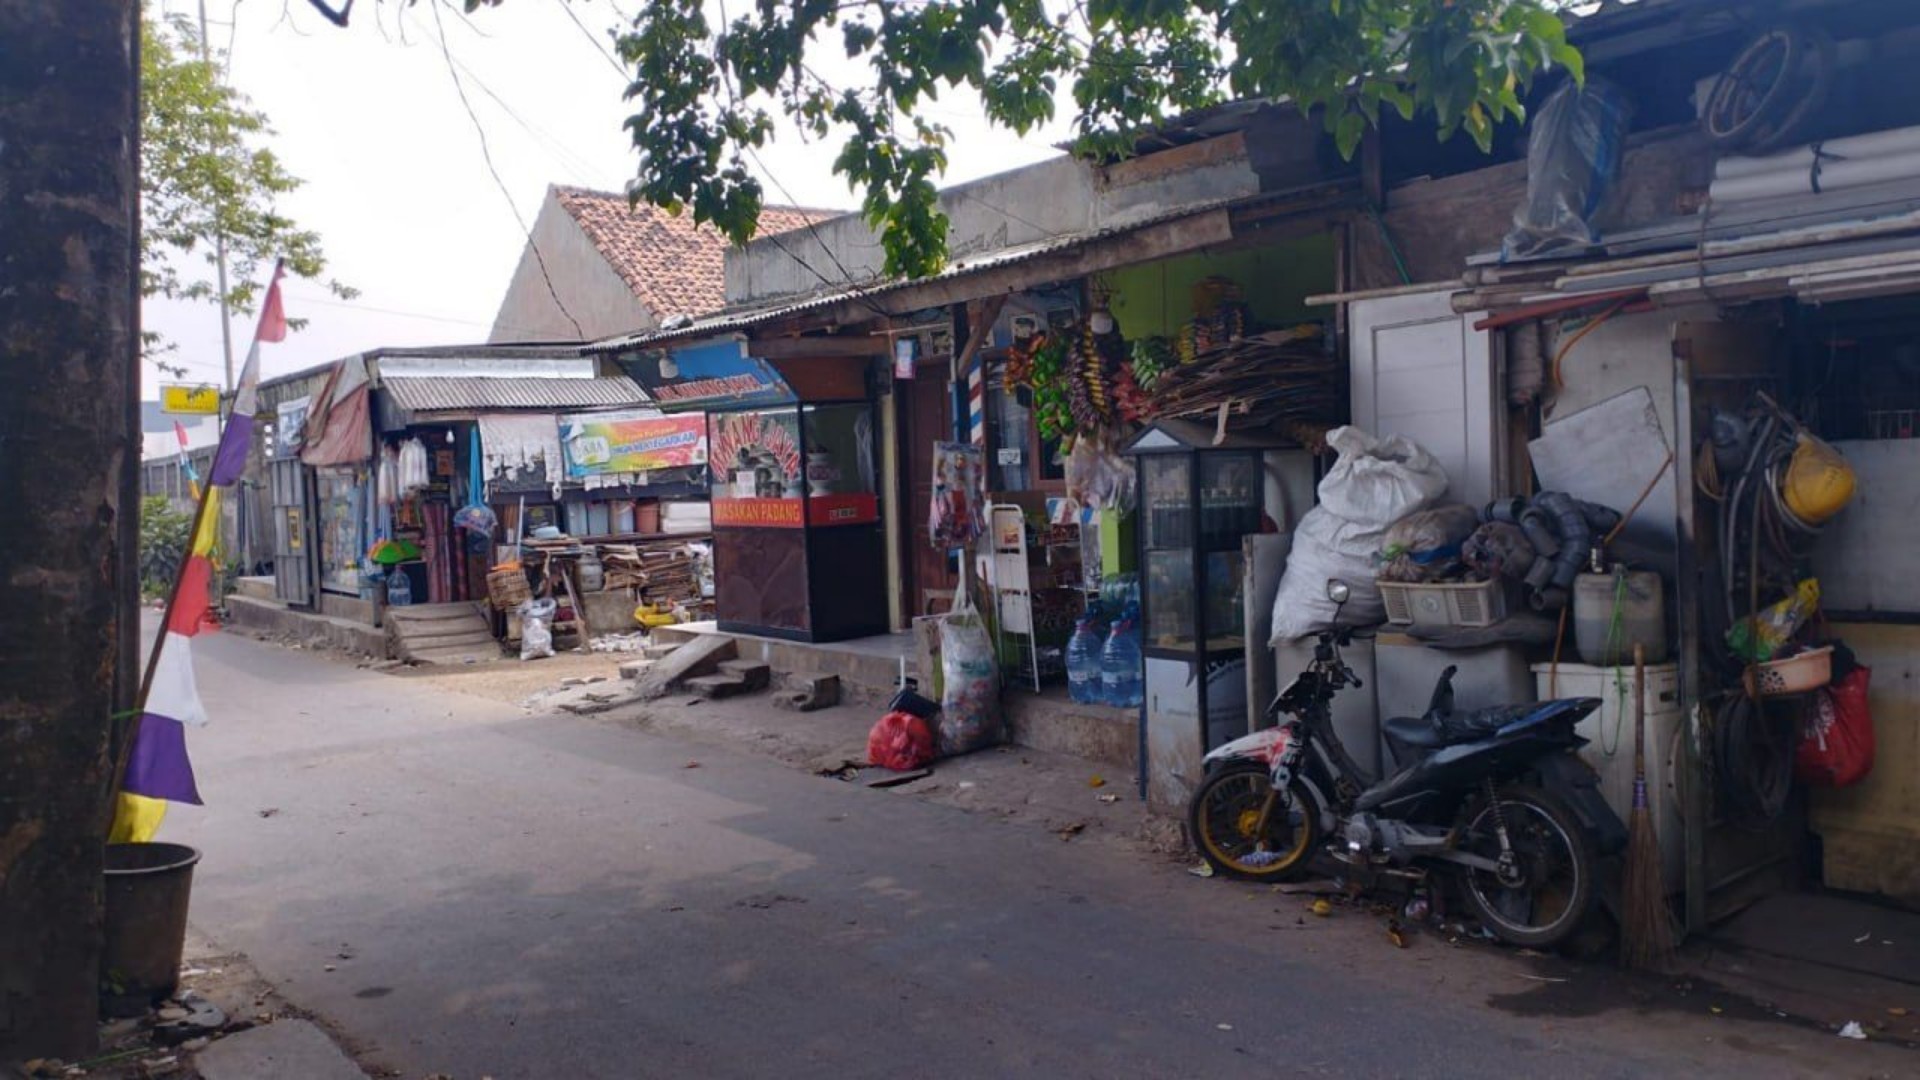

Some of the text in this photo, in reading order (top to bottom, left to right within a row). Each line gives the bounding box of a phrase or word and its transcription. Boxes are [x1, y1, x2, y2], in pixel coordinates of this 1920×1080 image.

[763, 419, 801, 481] JAYA
[714, 502, 800, 522] MASAKAN PADANG
